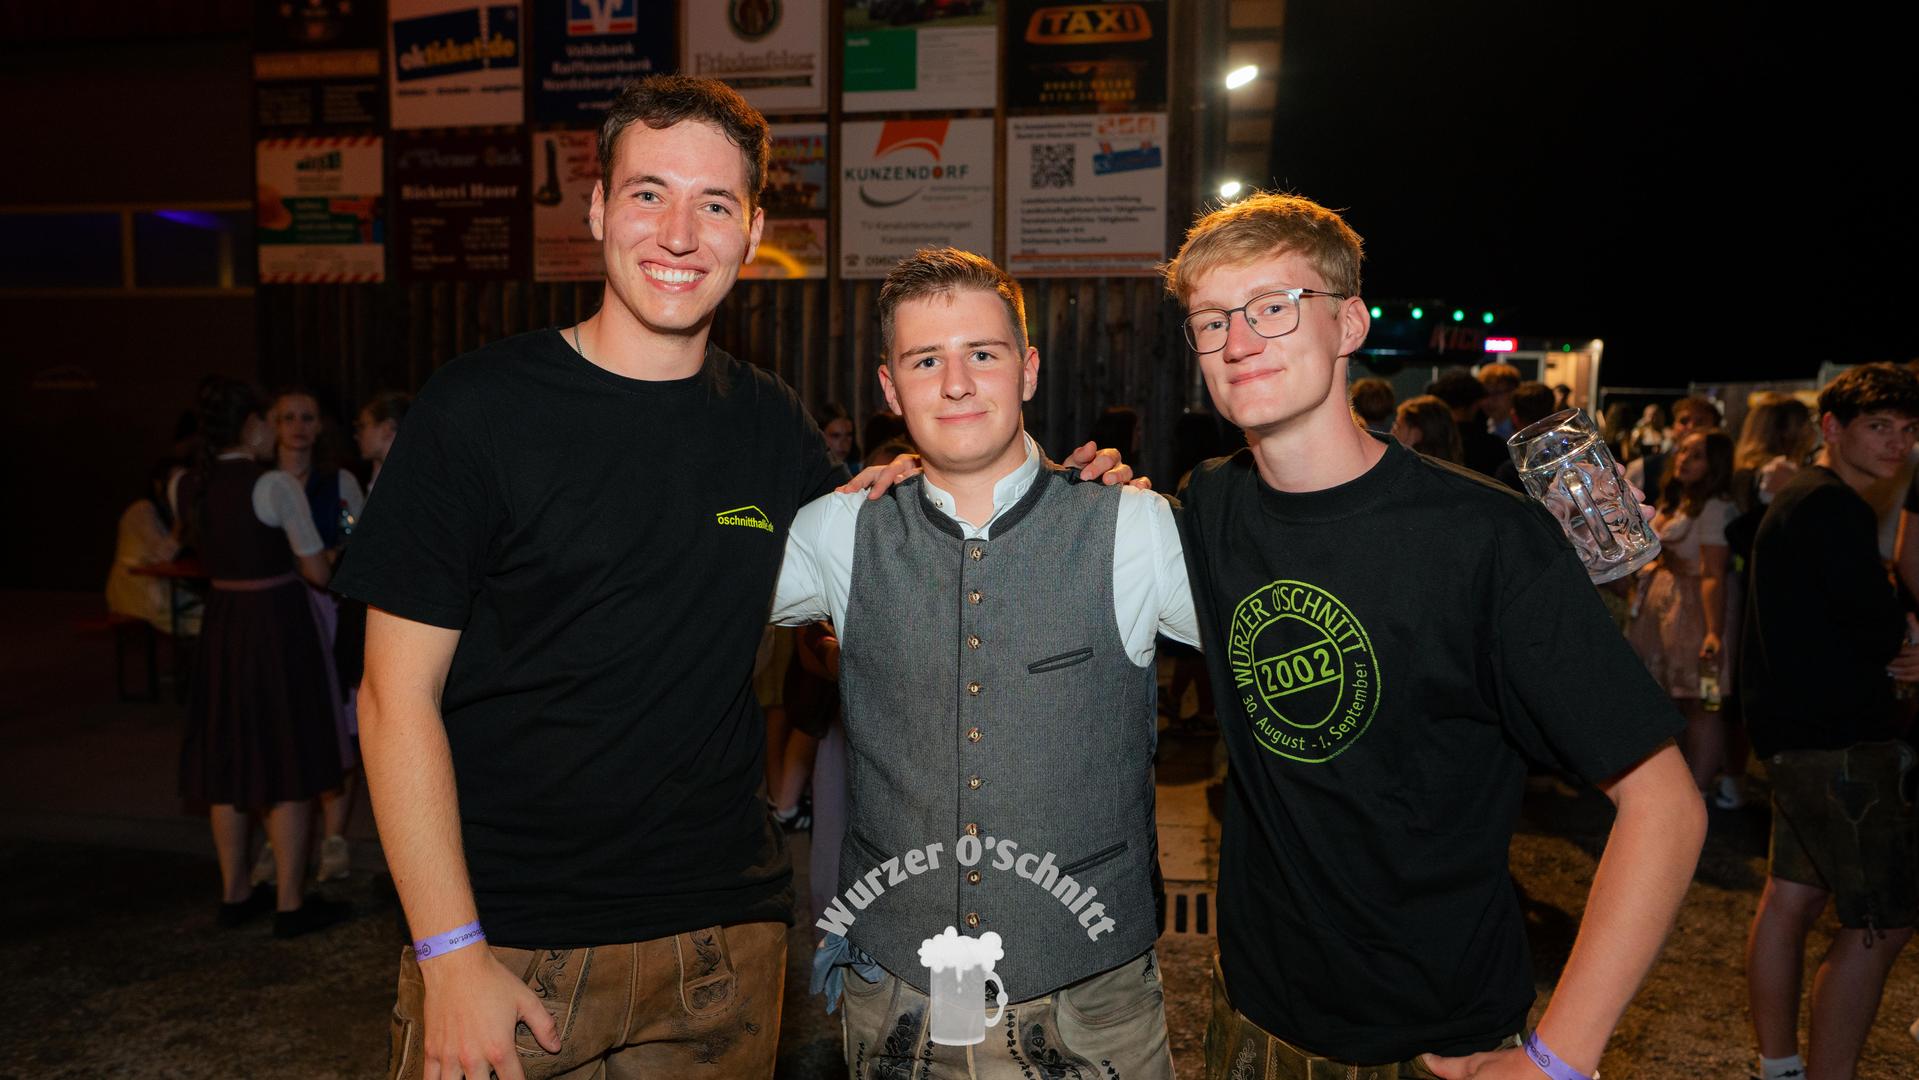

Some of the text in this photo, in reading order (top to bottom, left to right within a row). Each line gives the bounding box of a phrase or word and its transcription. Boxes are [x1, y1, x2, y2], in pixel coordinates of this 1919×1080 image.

[1040, 9, 1138, 35] TAXI
[565, 42, 635, 57] Volksbank
[552, 59, 652, 74] Raiffeisenbank
[844, 165, 971, 181] KUNZENDORF
[1232, 597, 1271, 689] WURZER
[1261, 648, 1335, 692] 2002
[1242, 694, 1257, 718] 30.
[1256, 717, 1305, 751] August
[1329, 662, 1368, 740] September
